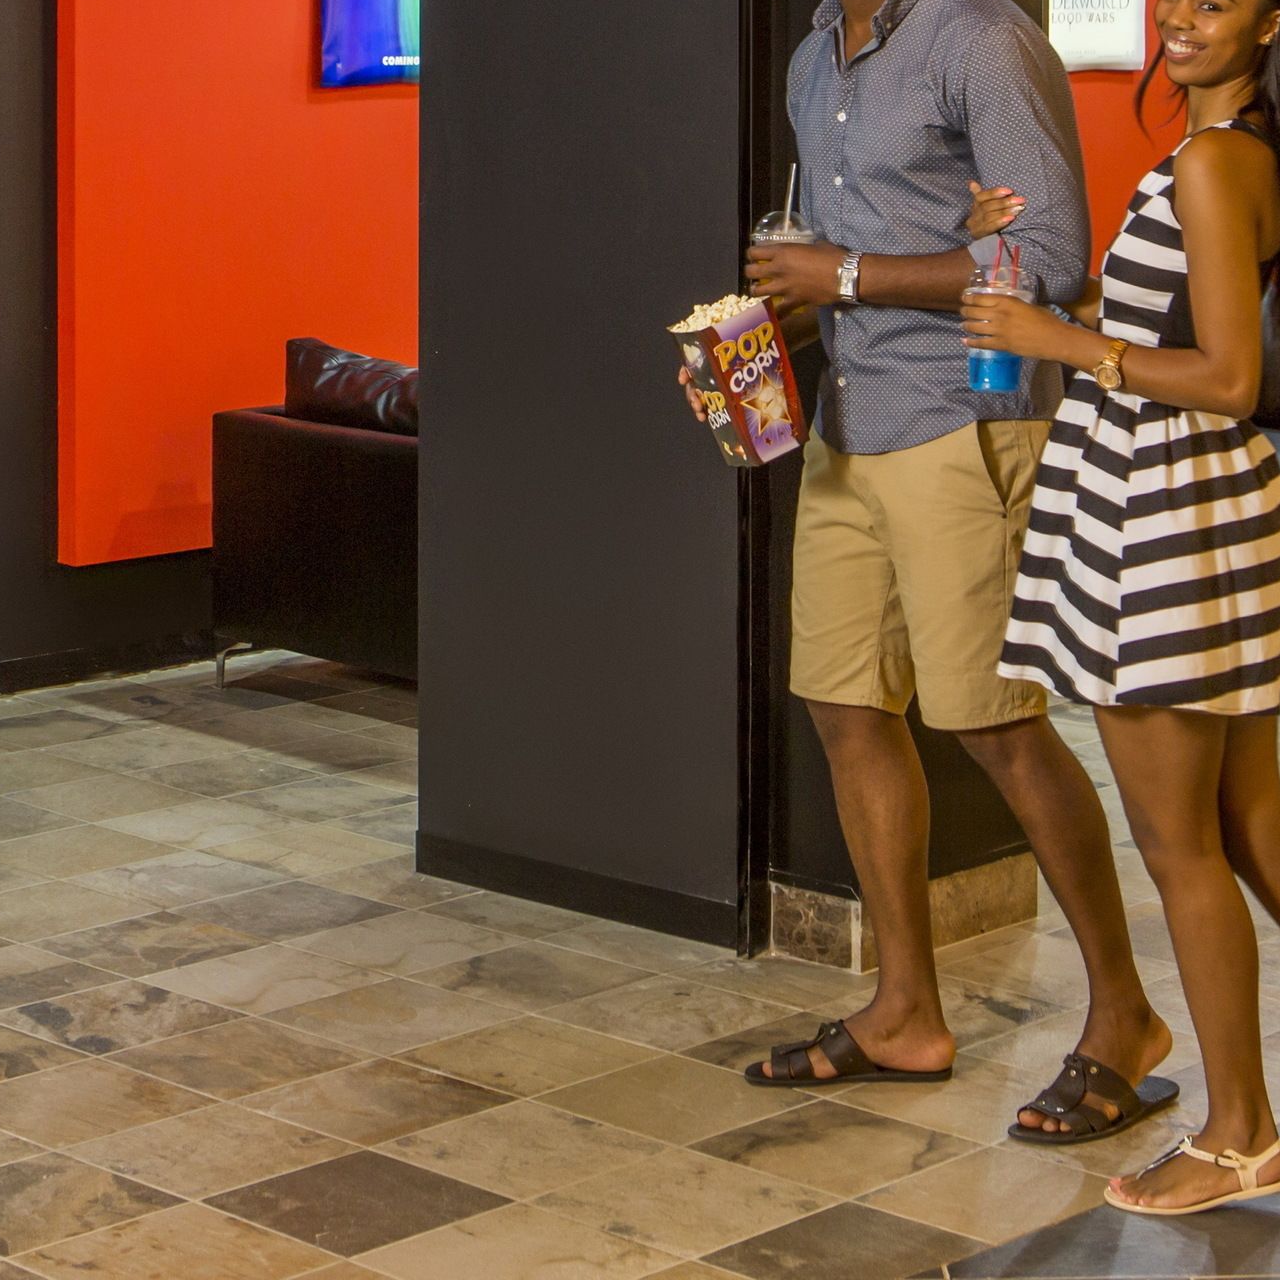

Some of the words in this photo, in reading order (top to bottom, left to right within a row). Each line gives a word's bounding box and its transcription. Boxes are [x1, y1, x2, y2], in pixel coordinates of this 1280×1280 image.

[713, 321, 775, 373] POP
[729, 340, 781, 393] CORN
[707, 407, 731, 430] CORN
